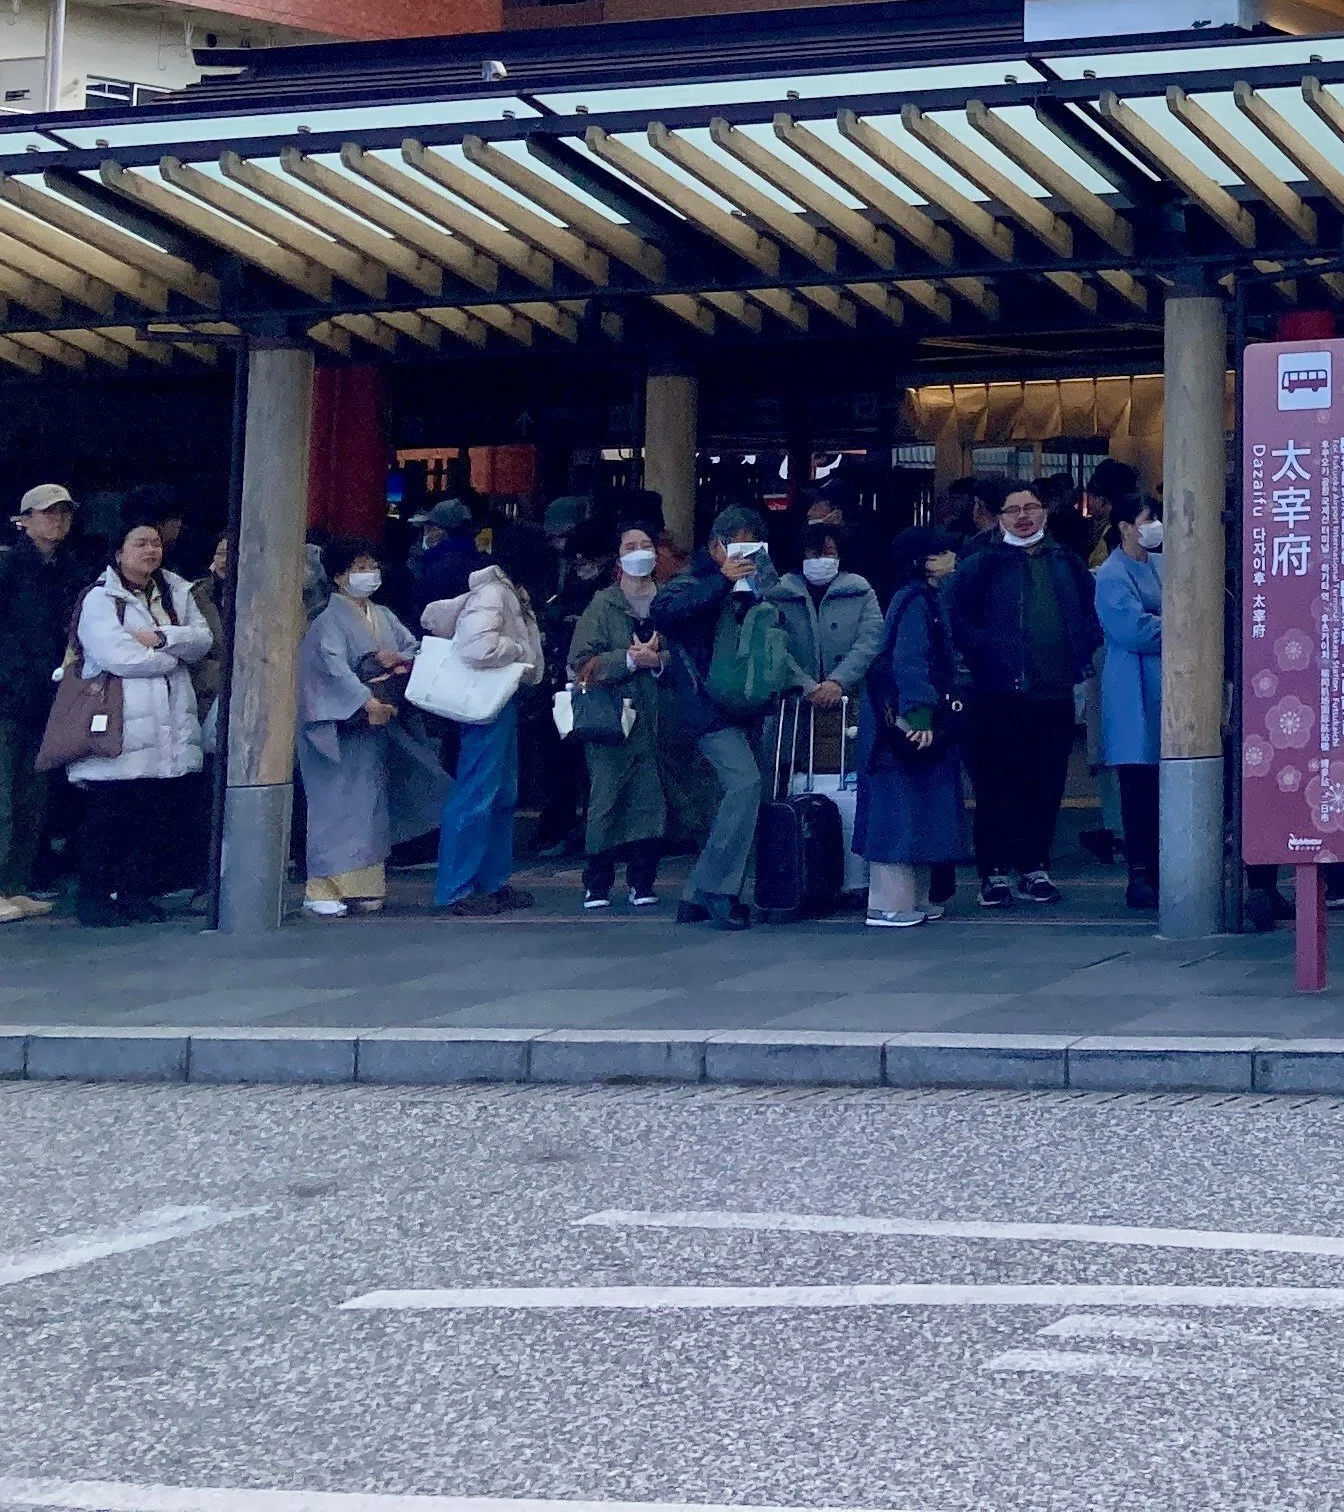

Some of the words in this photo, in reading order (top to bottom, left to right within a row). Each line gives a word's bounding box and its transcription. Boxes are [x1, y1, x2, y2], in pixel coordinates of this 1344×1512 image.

[1252, 444, 1266, 518] Dazaifu
[1331, 455, 1340, 492] Fukuoka
[1271, 439, 1312, 577] 太宰府
[1331, 494, 1340, 524] Airport
[1252, 526, 1266, 587] 다자이후
[1331, 526, 1340, 582] International
[1252, 593, 1266, 639] 太宰府
